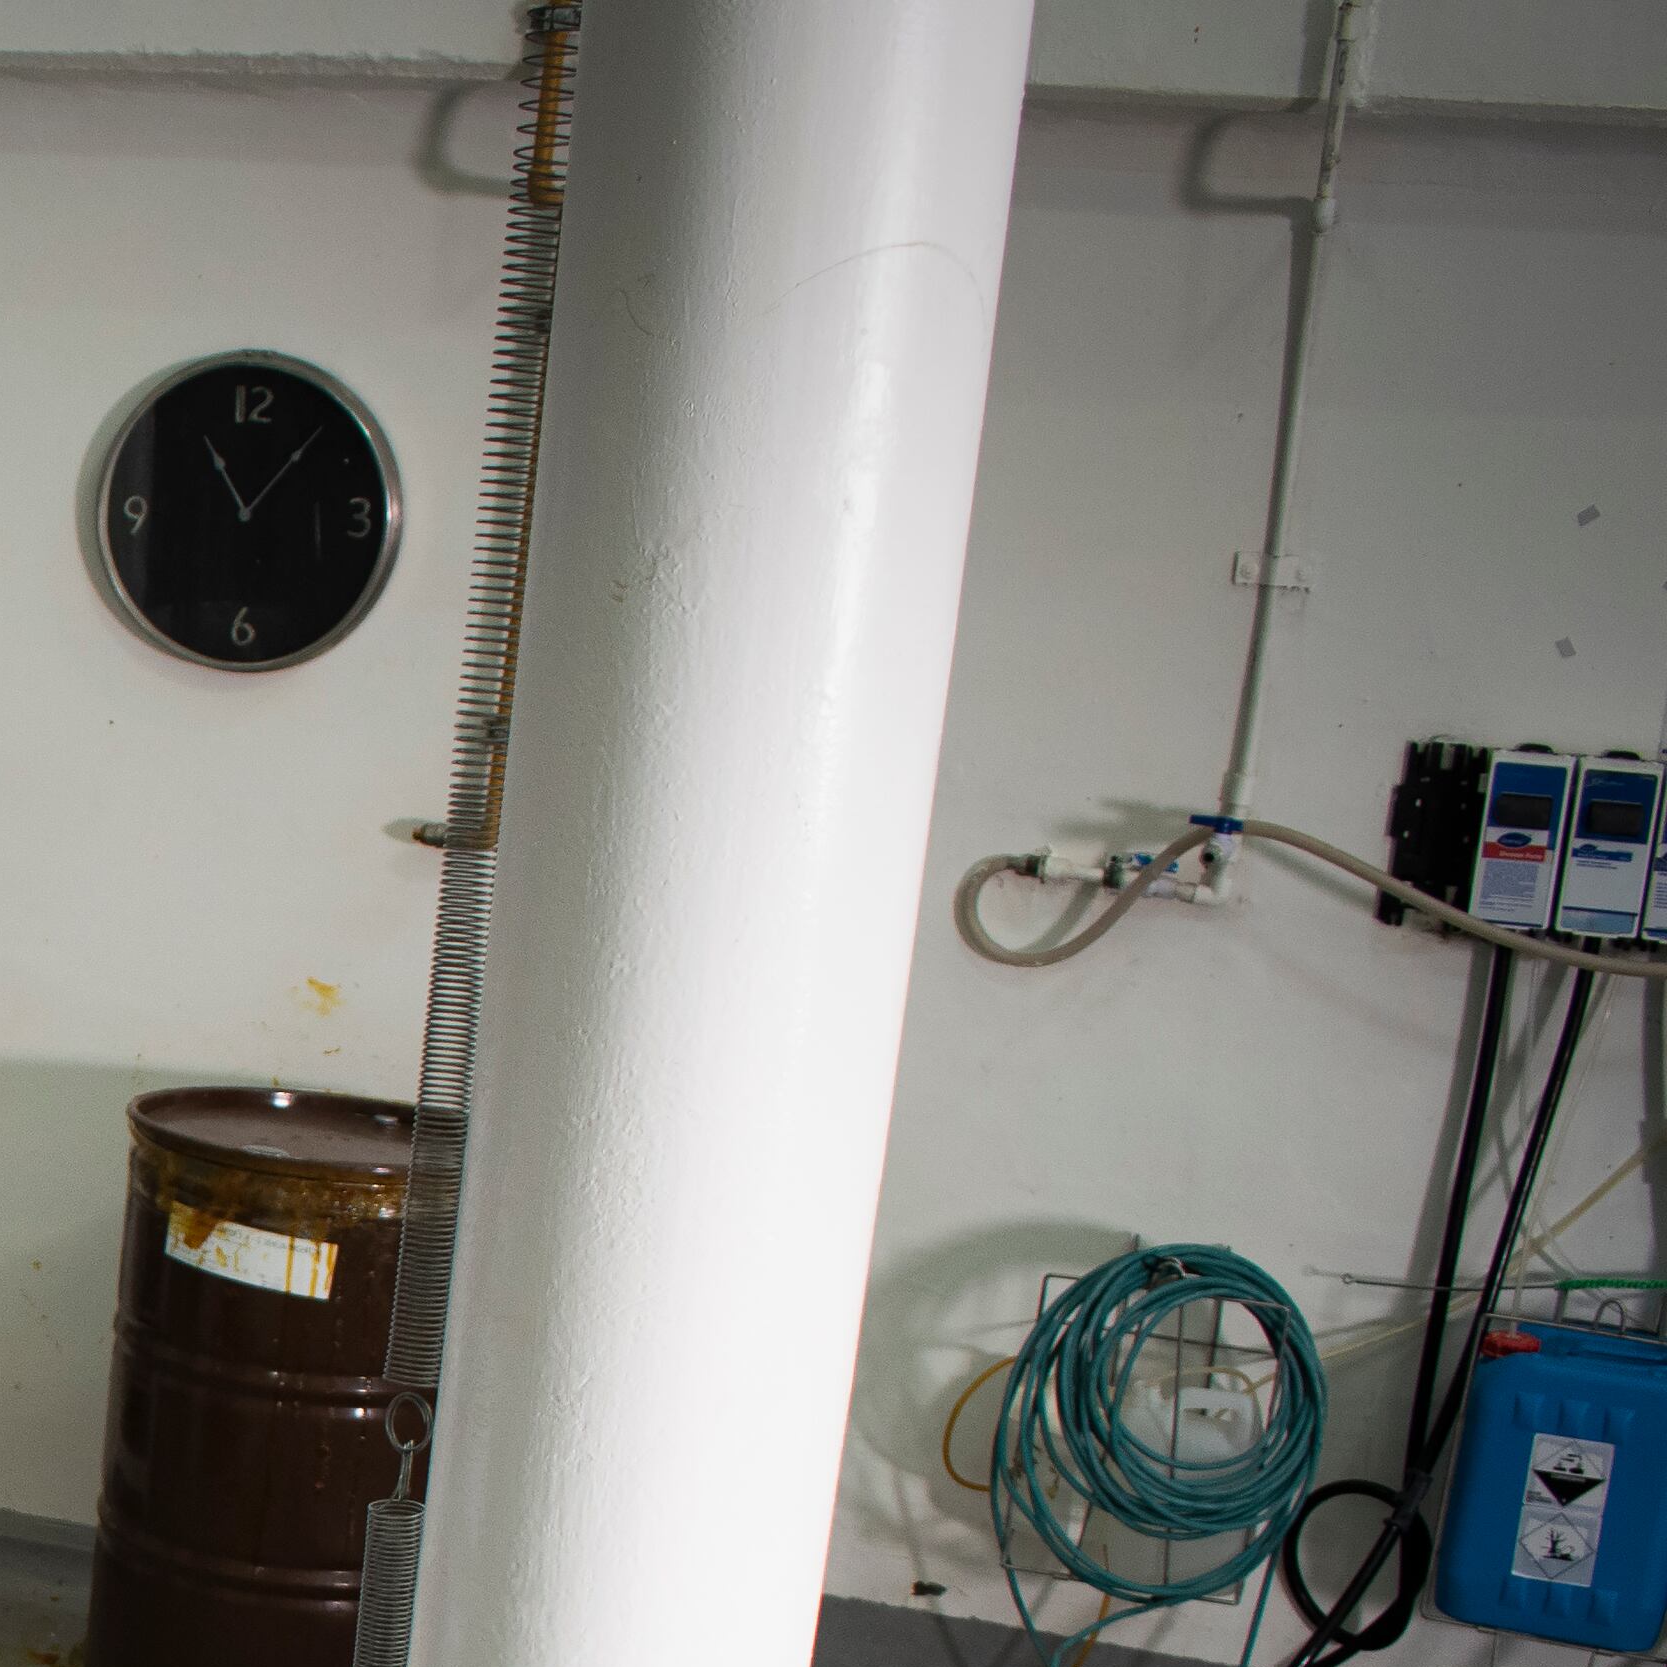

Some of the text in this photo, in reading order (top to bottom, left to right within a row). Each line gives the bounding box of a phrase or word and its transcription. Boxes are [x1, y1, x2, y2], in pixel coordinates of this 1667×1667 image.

[234, 383, 275, 424] 12
[123, 495, 149, 536] 9
[346, 497, 372, 538] 3
[231, 606, 257, 646] 6
